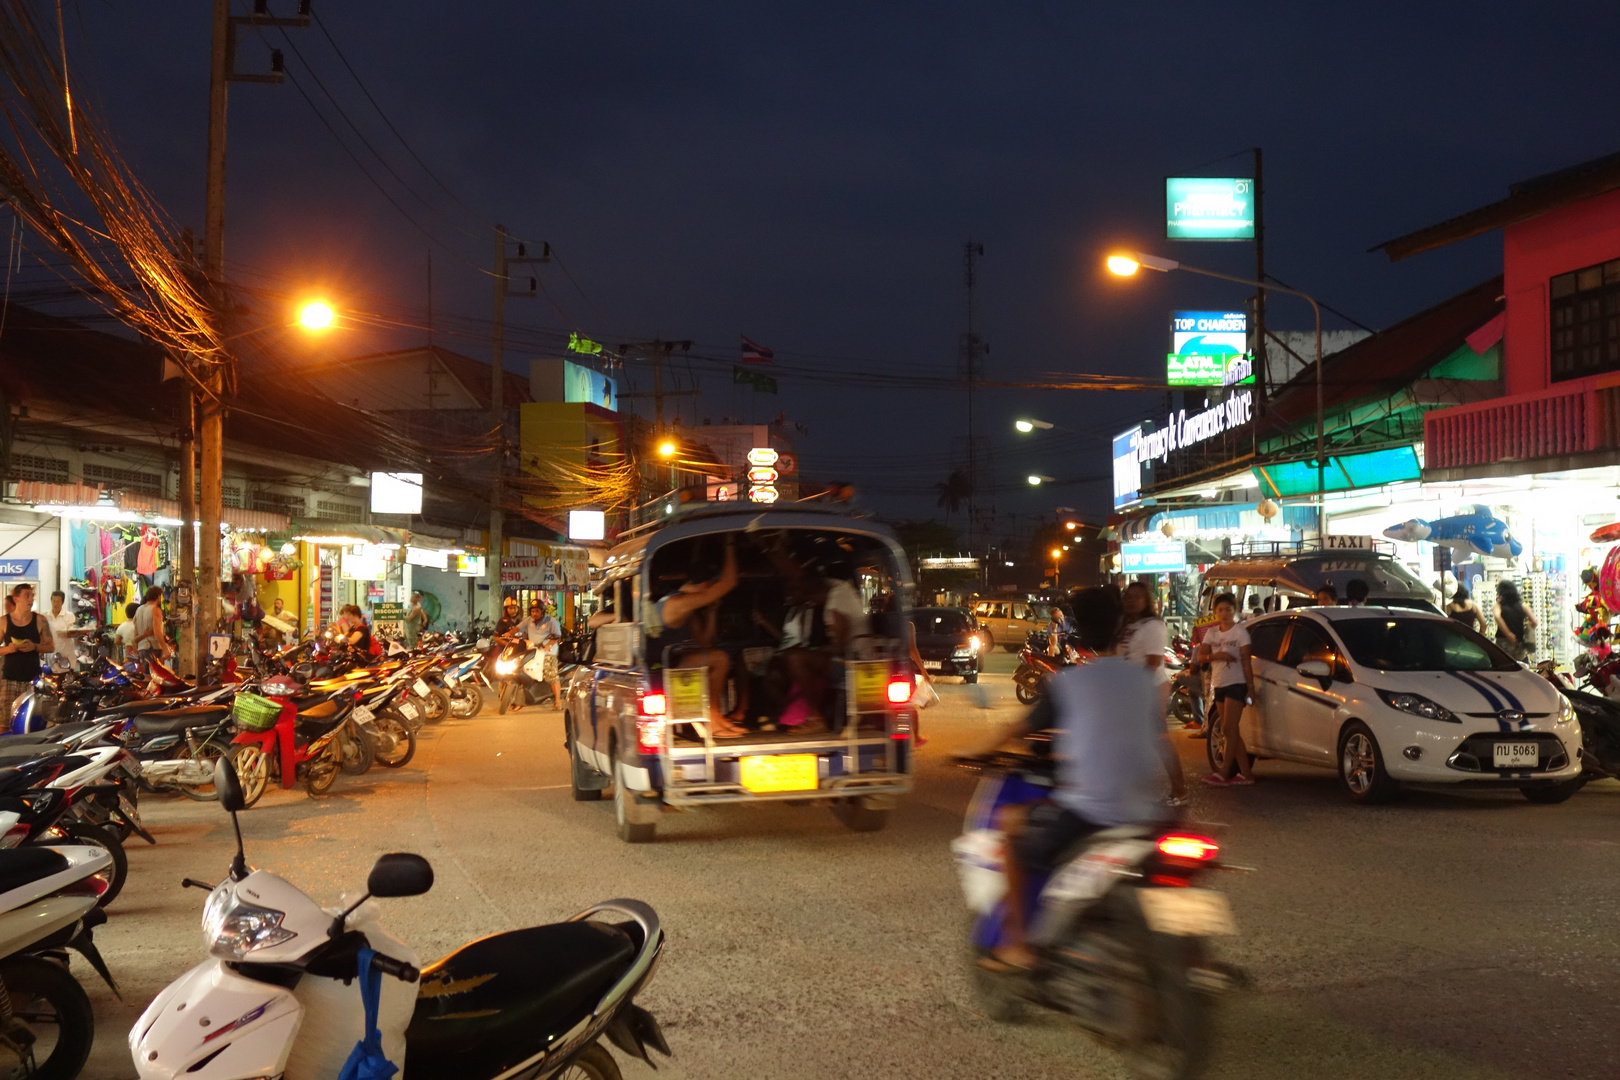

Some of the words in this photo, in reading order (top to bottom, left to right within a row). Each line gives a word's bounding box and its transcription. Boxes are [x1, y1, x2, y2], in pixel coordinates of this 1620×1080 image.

[1236, 183, 1248, 194] 01
[1174, 318, 1195, 330] TOP
[1198, 319, 1246, 331] CHAROEN
[1135, 426, 1169, 464] Pharmacy
[1168, 412, 1176, 452] &
[1178, 398, 1224, 448] Convenience
[1226, 390, 1252, 430] store
[1328, 536, 1364, 548] TAXI
[1196, 615, 1217, 624] TAXI
[1513, 745, 1536, 756] 5063
